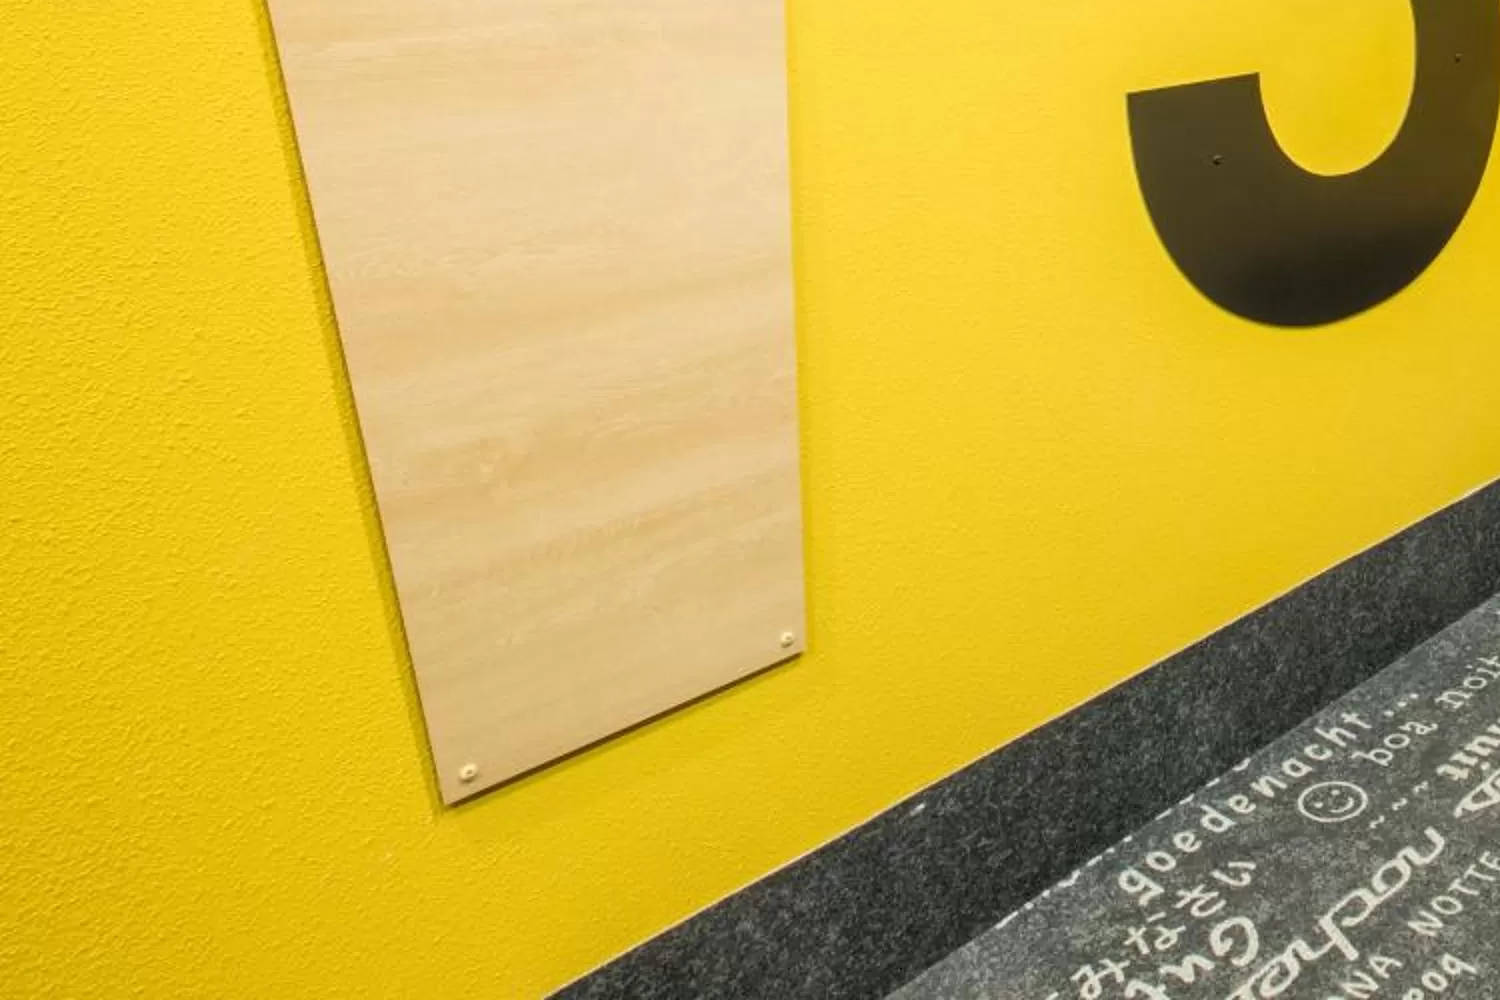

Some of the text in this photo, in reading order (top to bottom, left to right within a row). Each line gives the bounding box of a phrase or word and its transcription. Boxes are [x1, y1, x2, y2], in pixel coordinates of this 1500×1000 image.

[1352, 720, 1439, 766] boa
[1045, 861, 1256, 1000] みなさい
